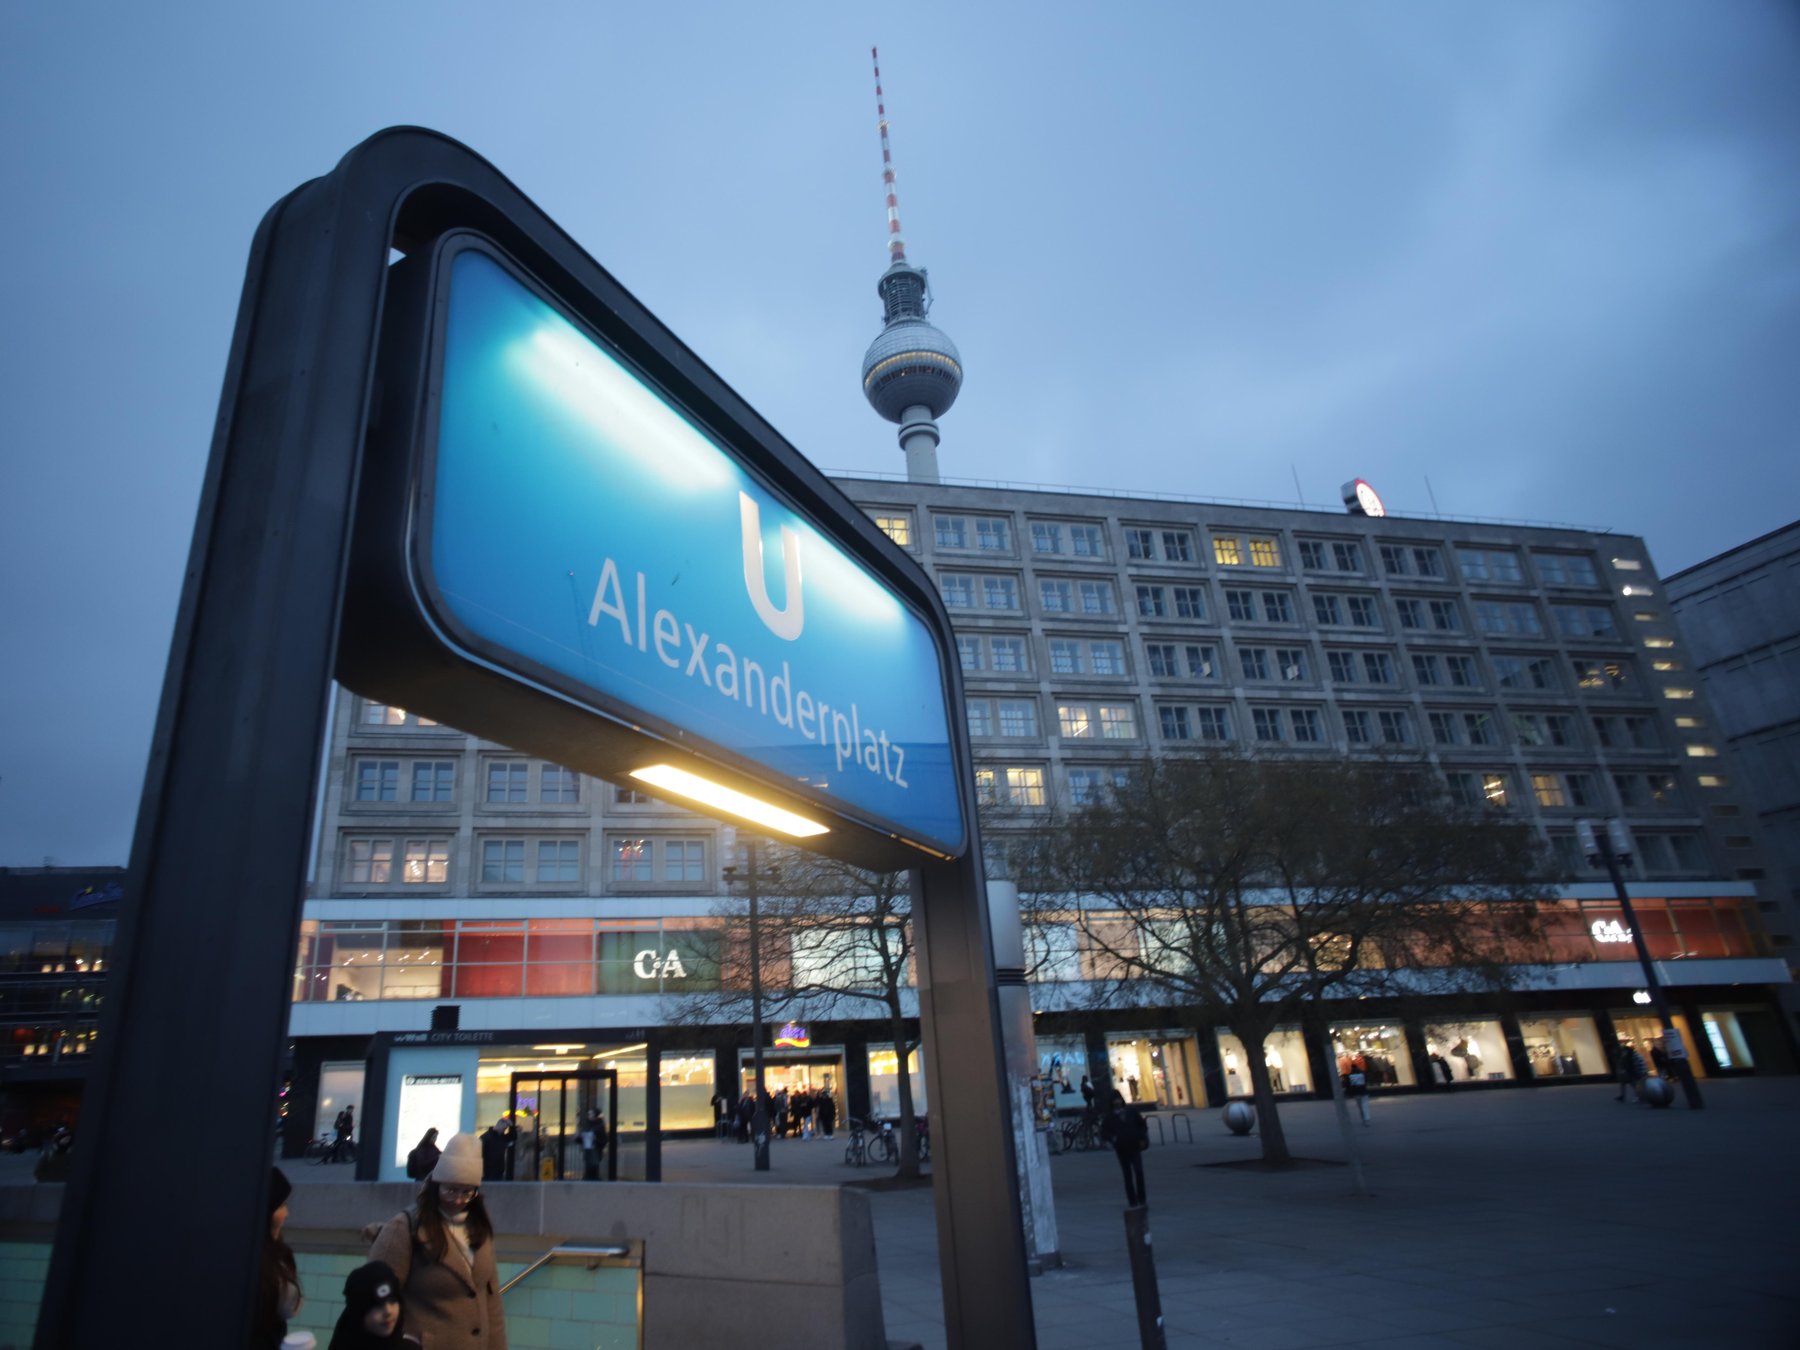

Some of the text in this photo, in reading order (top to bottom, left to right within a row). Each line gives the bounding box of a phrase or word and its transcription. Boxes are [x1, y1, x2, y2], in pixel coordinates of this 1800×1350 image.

[739, 491, 804, 641] U
[587, 558, 908, 789] Alexanderplatz
[633, 949, 687, 979] C&A
[430, 1032, 452, 1042] CITY
[454, 1031, 495, 1041] TOILETTE
